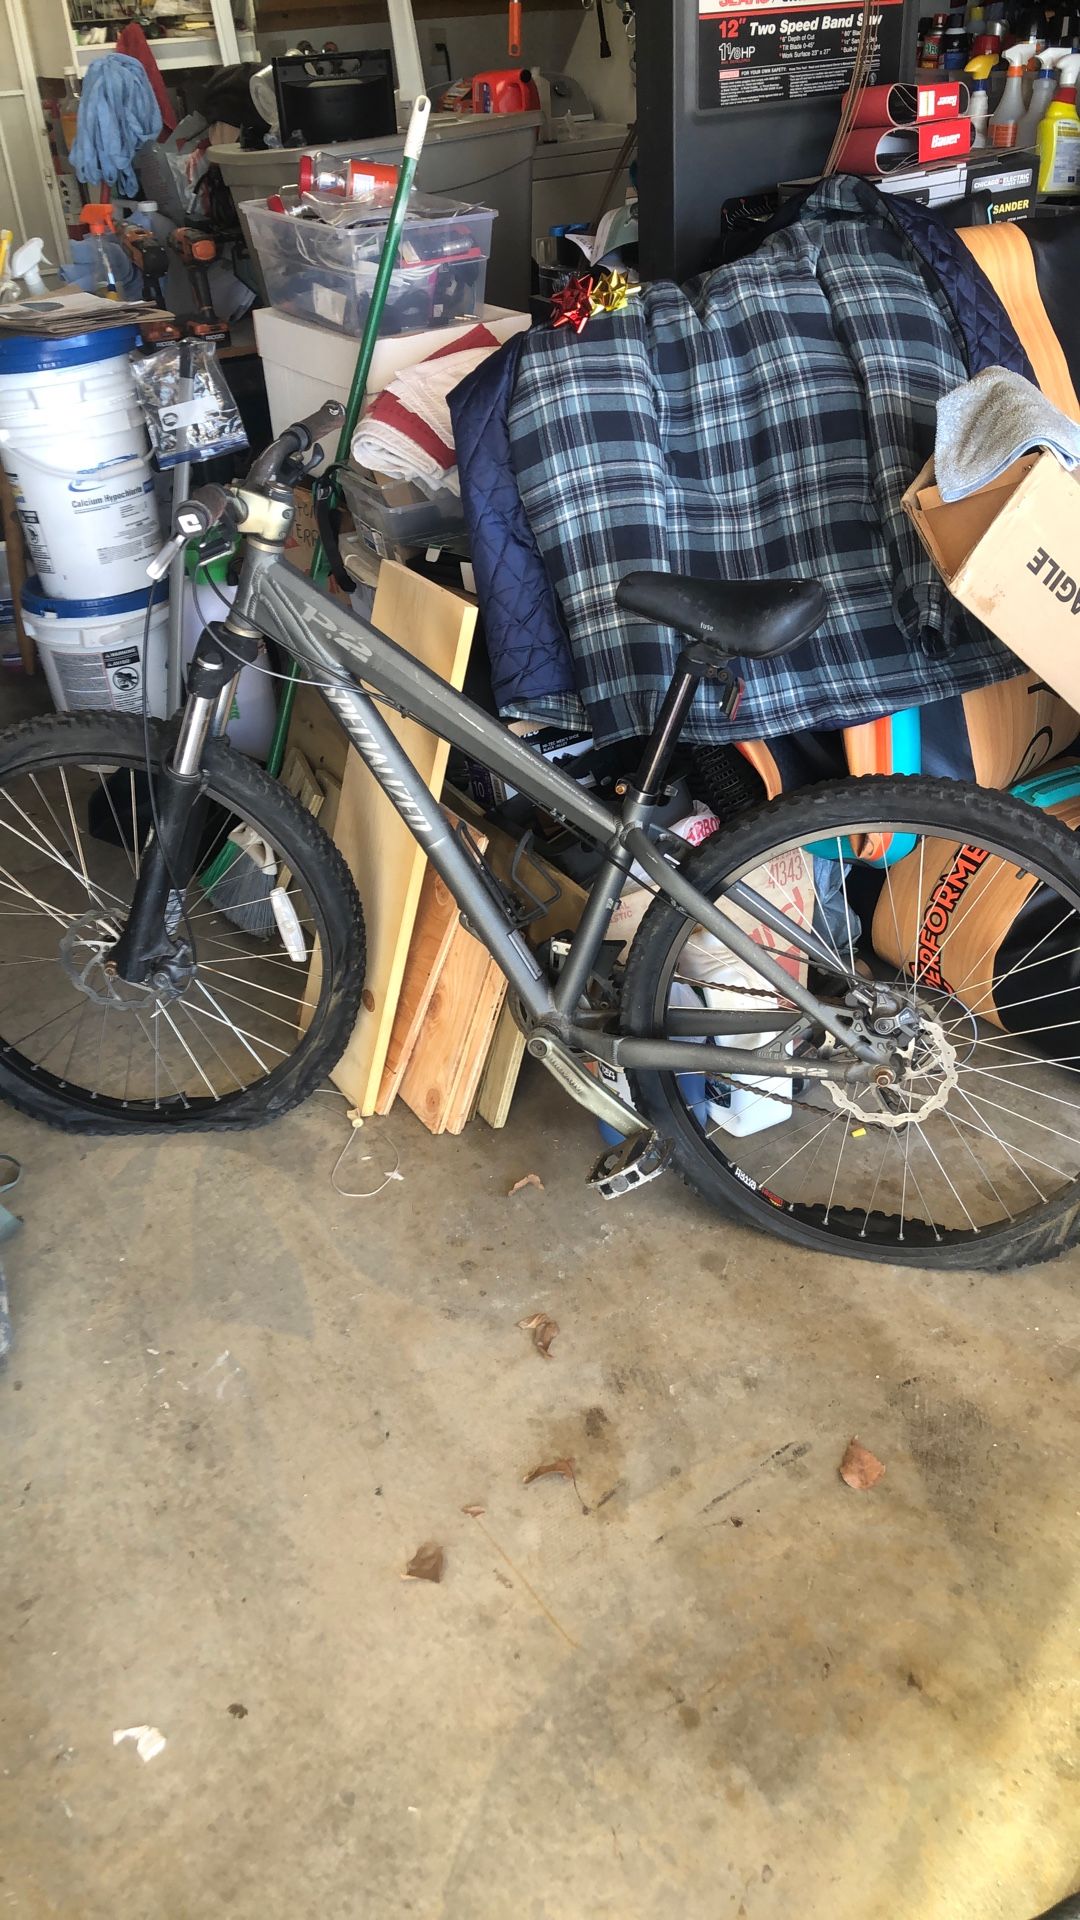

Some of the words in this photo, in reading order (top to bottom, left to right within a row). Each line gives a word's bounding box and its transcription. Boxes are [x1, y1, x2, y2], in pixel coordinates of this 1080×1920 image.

[719, 18, 746, 38] 12"
[750, 22, 776, 36] Two
[779, 18, 819, 35] Speed
[822, 14, 854, 30] Band
[857, 13, 883, 27] Sw
[931, 133, 961, 149] Bauer
[1002, 173, 1030, 184] ELECTRIC
[992, 199, 1030, 215] SANDER
[72, 497, 103, 508] Calcium
[104, 486, 143, 503] Hypochlorite
[700, 622, 714, 632] fuse
[323, 686, 433, 832] SPECIALIZED
